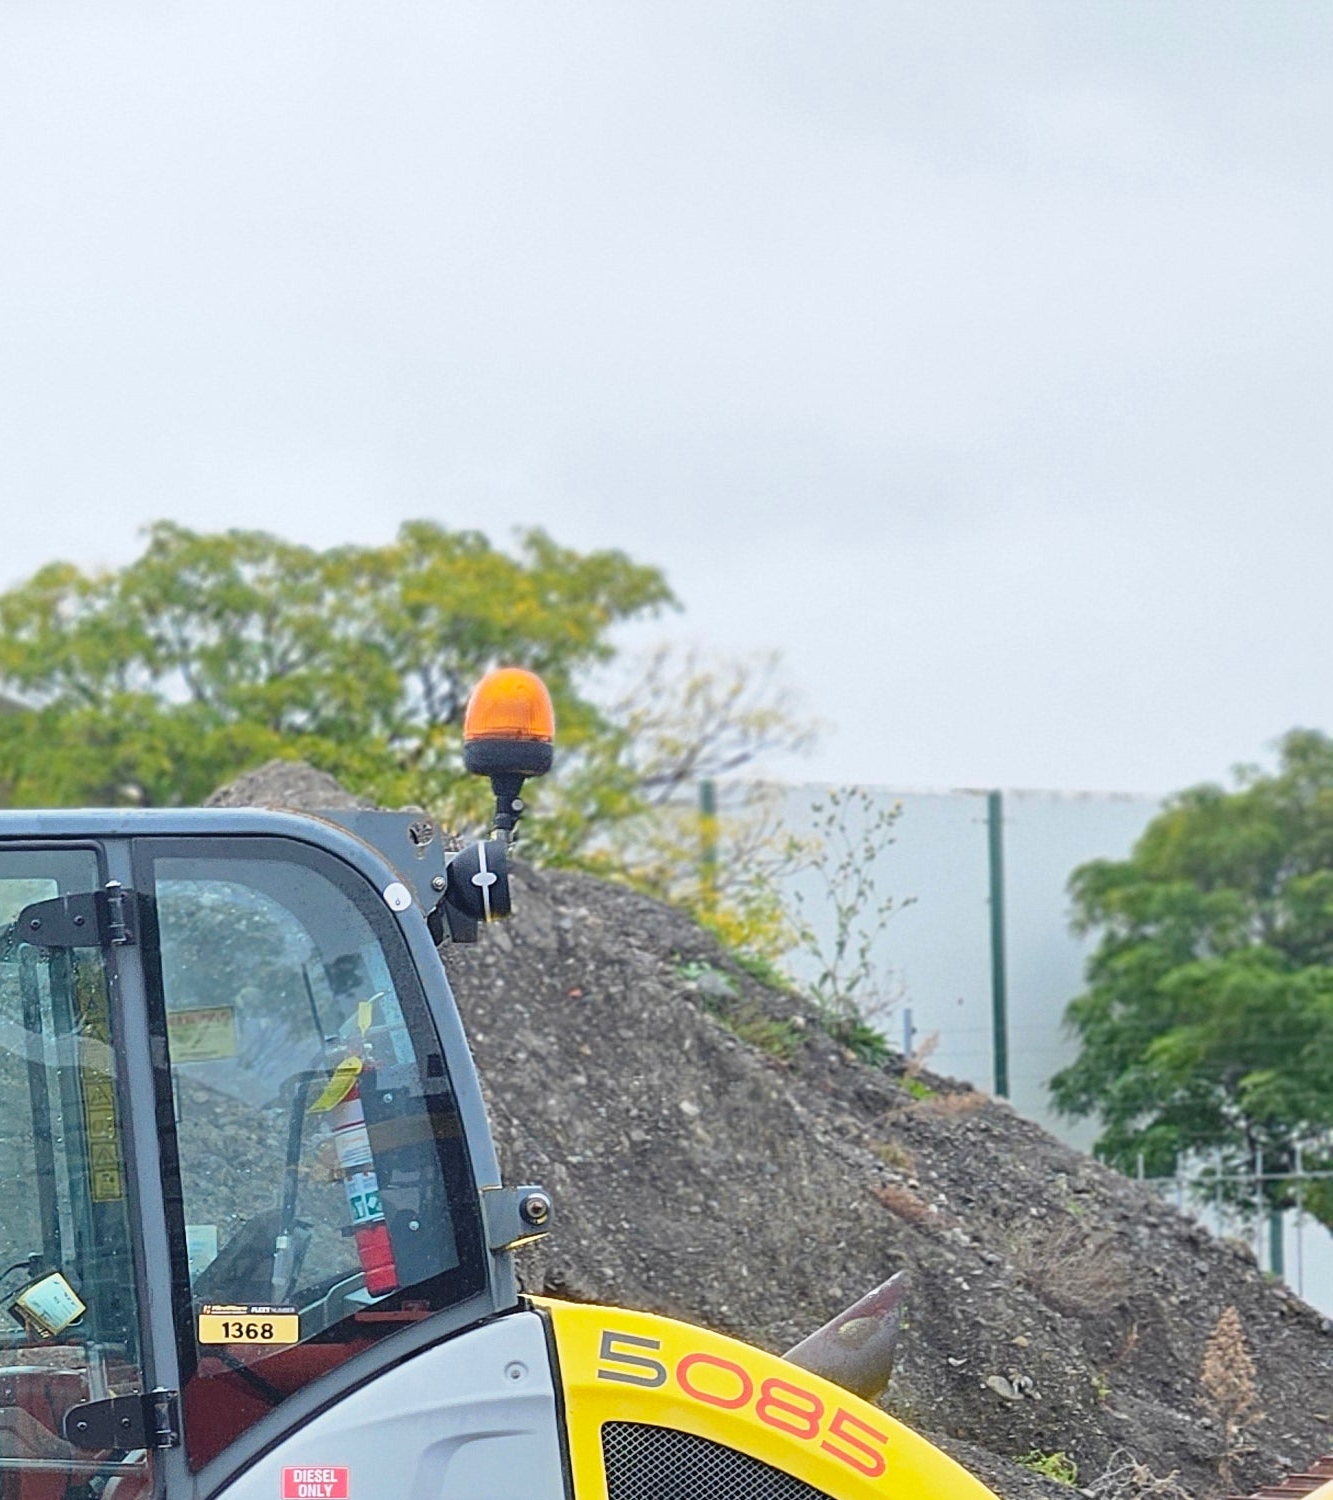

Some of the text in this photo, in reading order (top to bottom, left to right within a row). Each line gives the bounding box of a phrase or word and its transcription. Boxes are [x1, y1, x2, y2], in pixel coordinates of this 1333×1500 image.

[221, 1322, 274, 1340] 1368
[597, 1329, 889, 1478] 5085
[293, 1469, 338, 1483] DIESEL
[298, 1484, 334, 1498] ONLY
